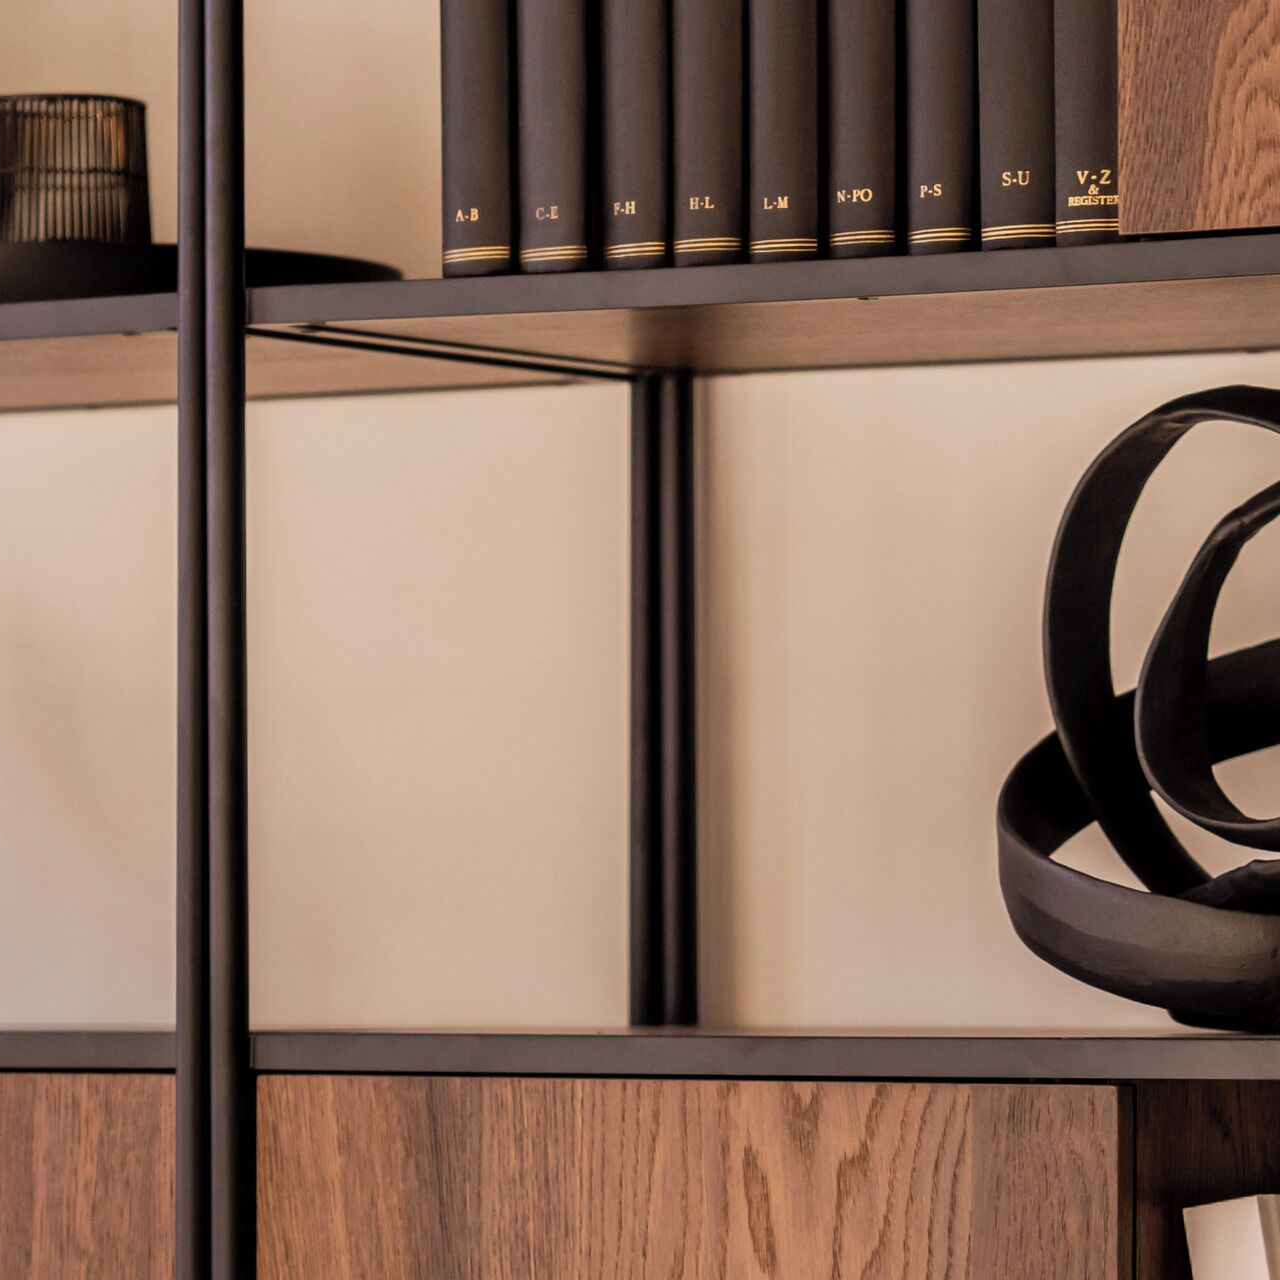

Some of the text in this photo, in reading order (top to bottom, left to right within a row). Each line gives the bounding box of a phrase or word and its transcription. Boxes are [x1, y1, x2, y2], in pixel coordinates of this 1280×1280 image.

[1001, 171, 1030, 186] S-U
[836, 187, 872, 203] N-PO
[920, 183, 942, 198] P-S
[1087, 184, 1099, 195] &
[613, 201, 636, 216] F-H
[689, 196, 715, 210] H-L
[763, 195, 789, 210] L-M
[455, 207, 479, 222] A-B
[535, 205, 559, 220] C-E
